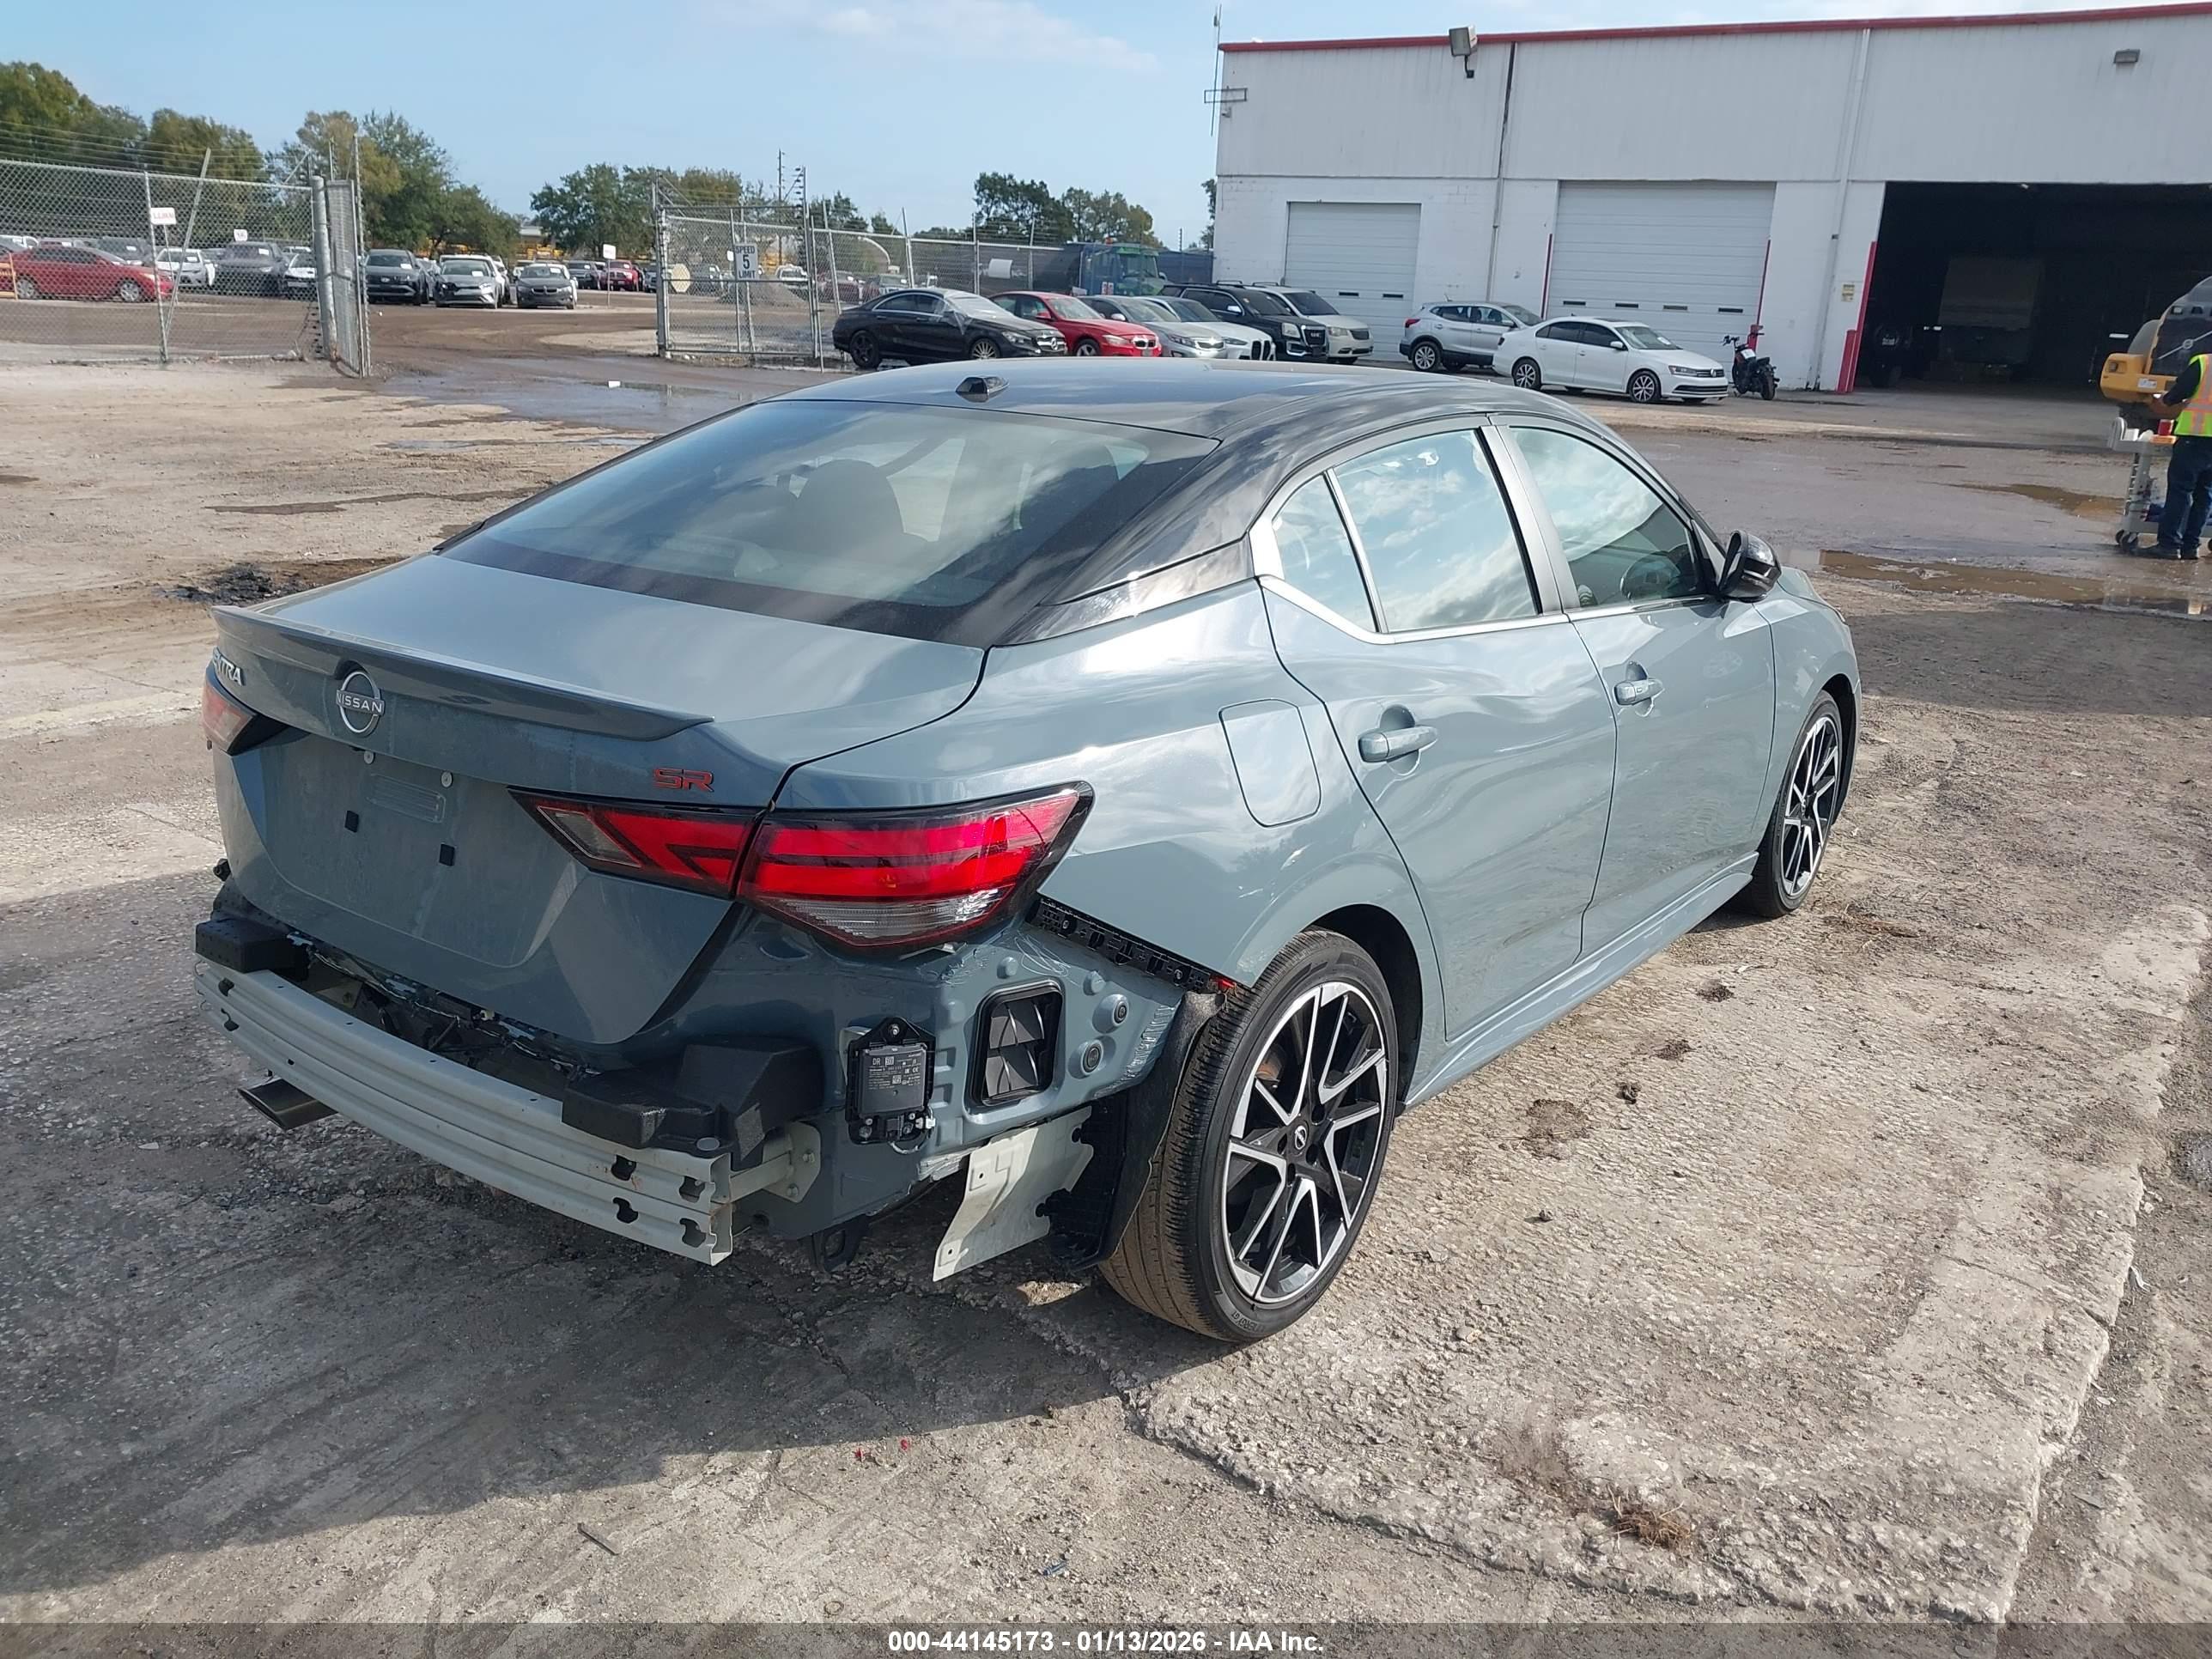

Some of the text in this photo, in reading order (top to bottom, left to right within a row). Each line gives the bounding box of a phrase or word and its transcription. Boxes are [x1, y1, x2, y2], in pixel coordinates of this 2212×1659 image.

[735, 246, 756, 254] SPEED
[743, 254, 750, 270] 5
[336, 691, 382, 714] NISSAN
[654, 768, 714, 792] SR
